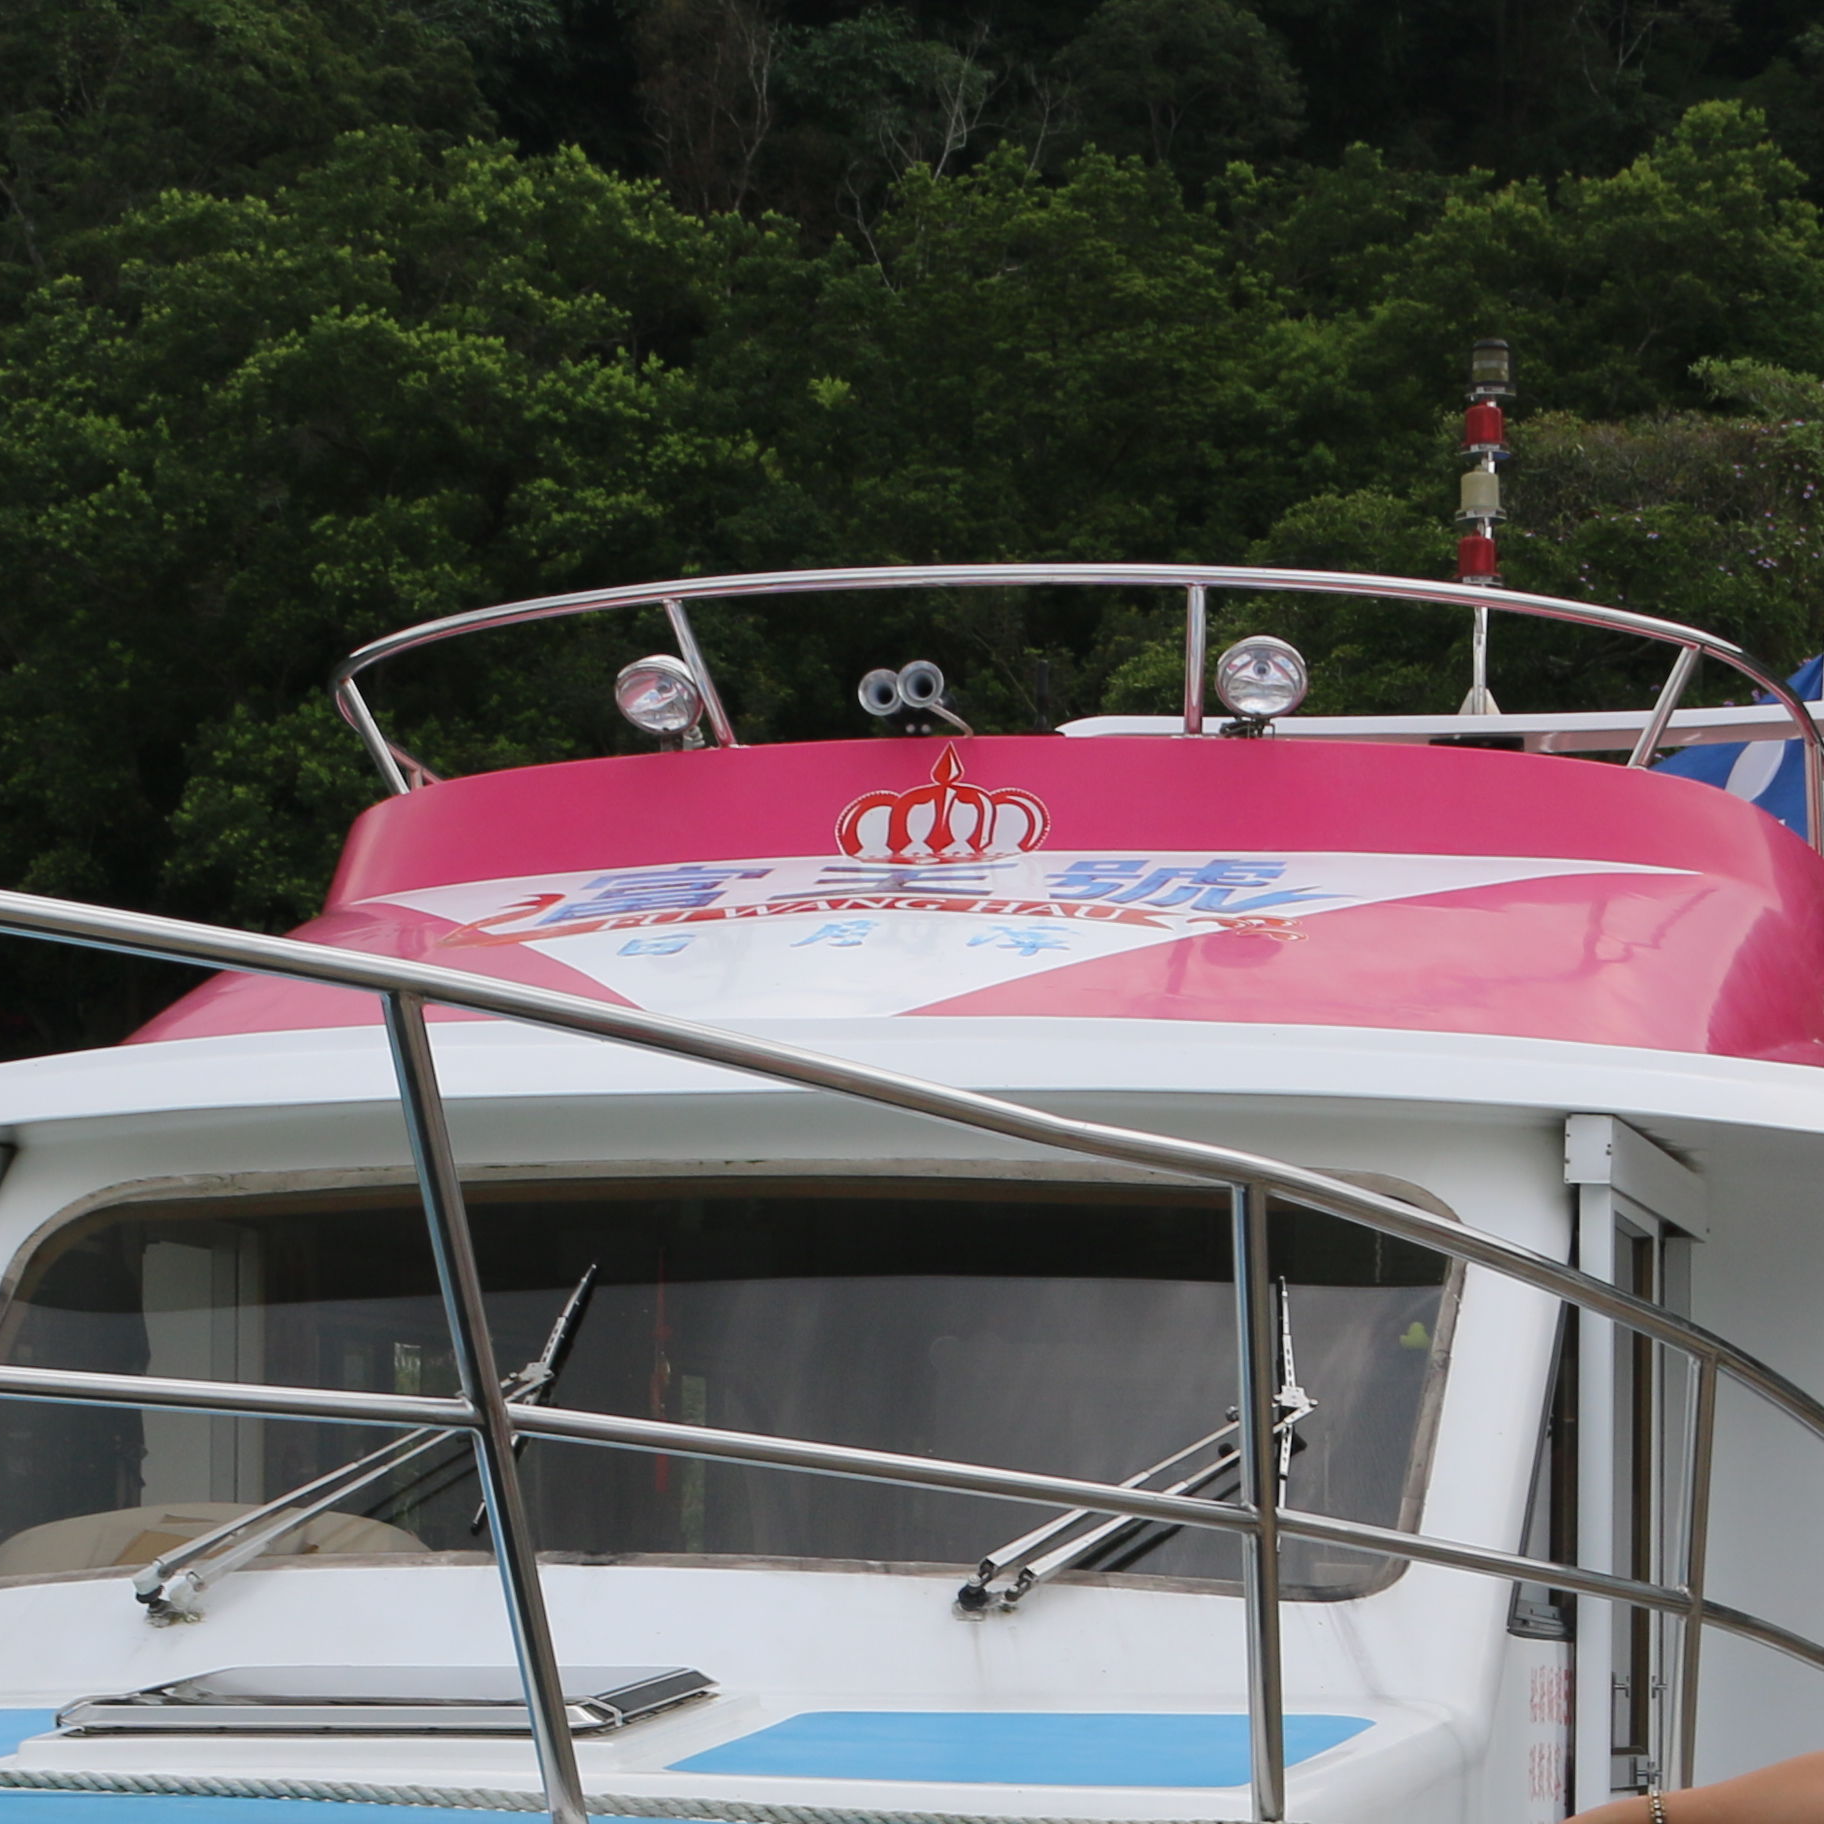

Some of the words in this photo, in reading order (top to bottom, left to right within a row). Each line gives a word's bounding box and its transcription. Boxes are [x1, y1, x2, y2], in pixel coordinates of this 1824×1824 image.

[596, 910, 694, 931] FU
[723, 897, 946, 919] WANG
[966, 900, 1126, 921] HAU
